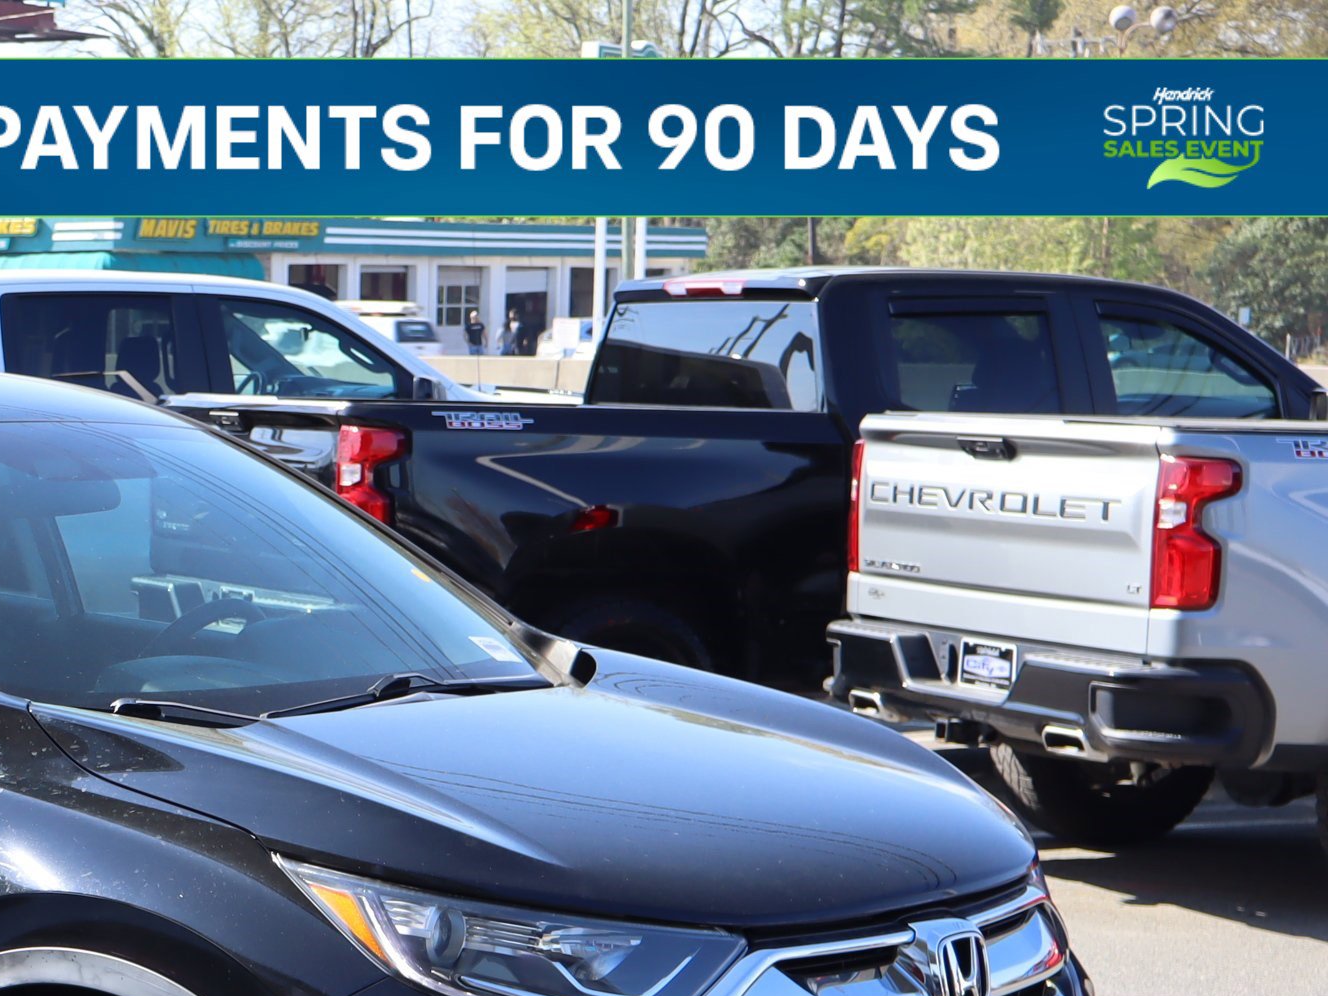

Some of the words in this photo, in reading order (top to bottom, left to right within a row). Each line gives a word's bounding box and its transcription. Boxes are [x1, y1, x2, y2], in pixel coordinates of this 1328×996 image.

[139, 219, 197, 238] MAVIS
[207, 220, 249, 234] TIRES
[262, 221, 319, 235] BRAKES
[871, 481, 1122, 522] CHEVROLET
